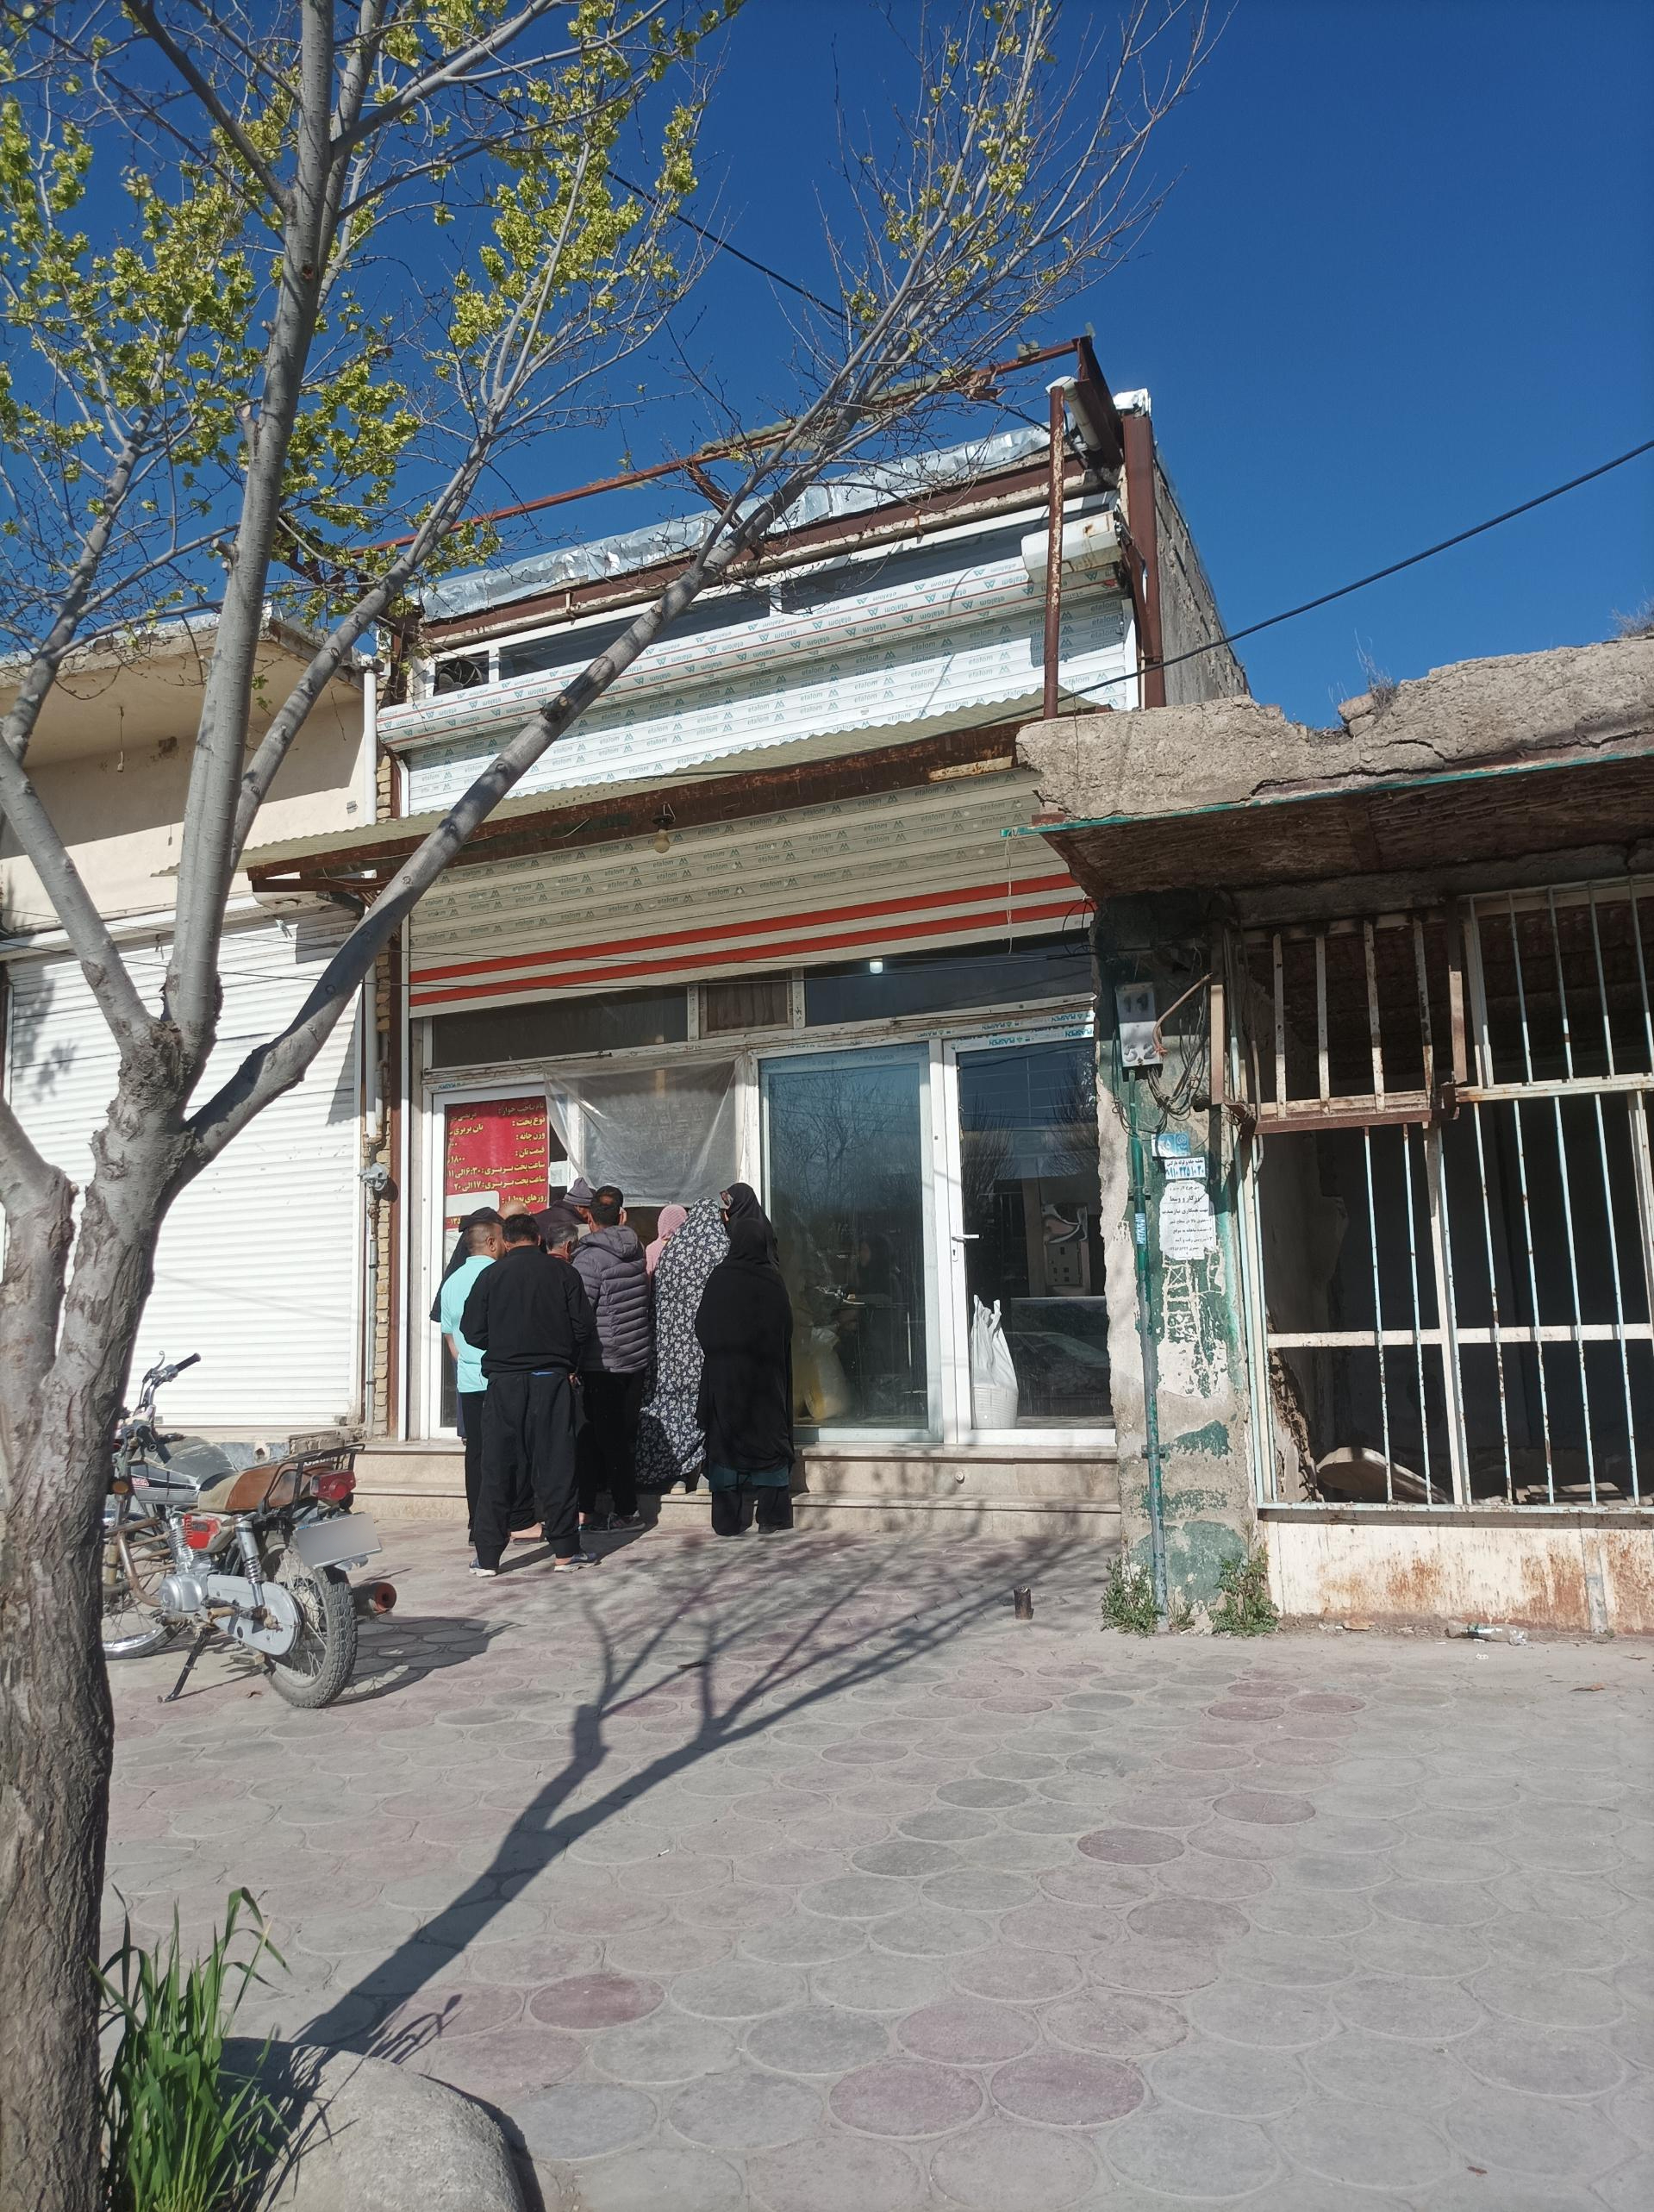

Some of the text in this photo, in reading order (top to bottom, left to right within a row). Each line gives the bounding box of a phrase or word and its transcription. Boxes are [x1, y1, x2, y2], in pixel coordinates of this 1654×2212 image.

[829, 615, 851, 625] etalom
[885, 602, 908, 612] etalom
[863, 622, 886, 632] etalom
[920, 609, 945, 619] etalom
[980, 595, 1005, 605] etalom
[1092, 615, 1118, 626] etalom
[857, 654, 878, 664] etalom
[912, 642, 935, 652] etalom
[1029, 617, 1045, 626] etal
[1091, 601, 1117, 611] etalom
[911, 668, 934, 678] etalom
[910, 682, 934, 691] etalom
